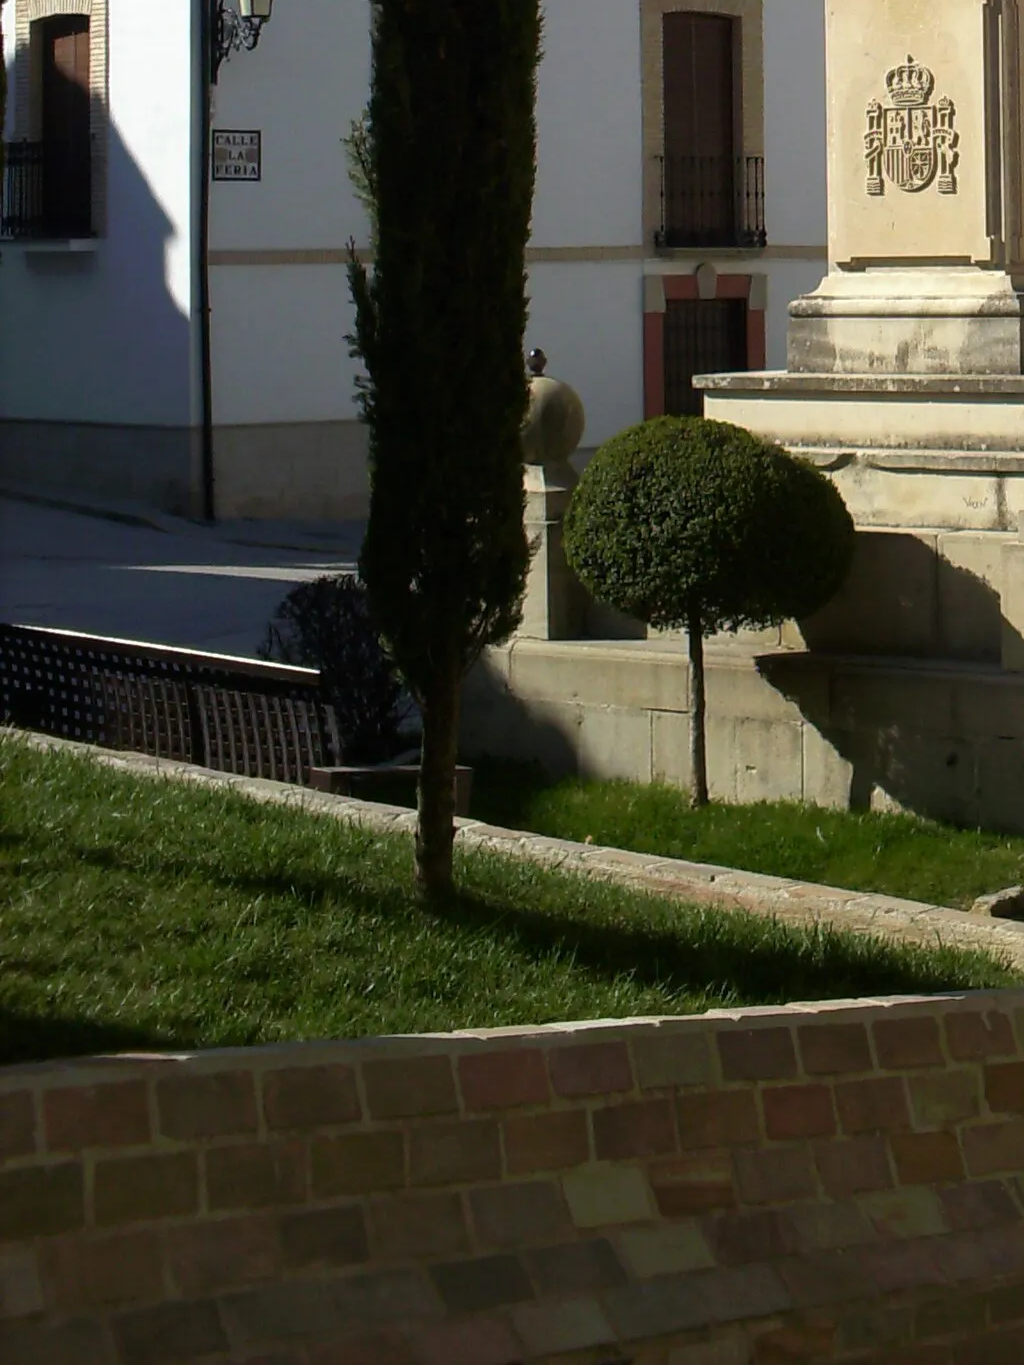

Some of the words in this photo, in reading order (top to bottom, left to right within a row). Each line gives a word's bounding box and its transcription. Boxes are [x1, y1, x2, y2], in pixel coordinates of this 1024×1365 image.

[215, 135, 257, 146] CALLE
[228, 150, 244, 160] LA
[215, 165, 257, 175] FERIA
